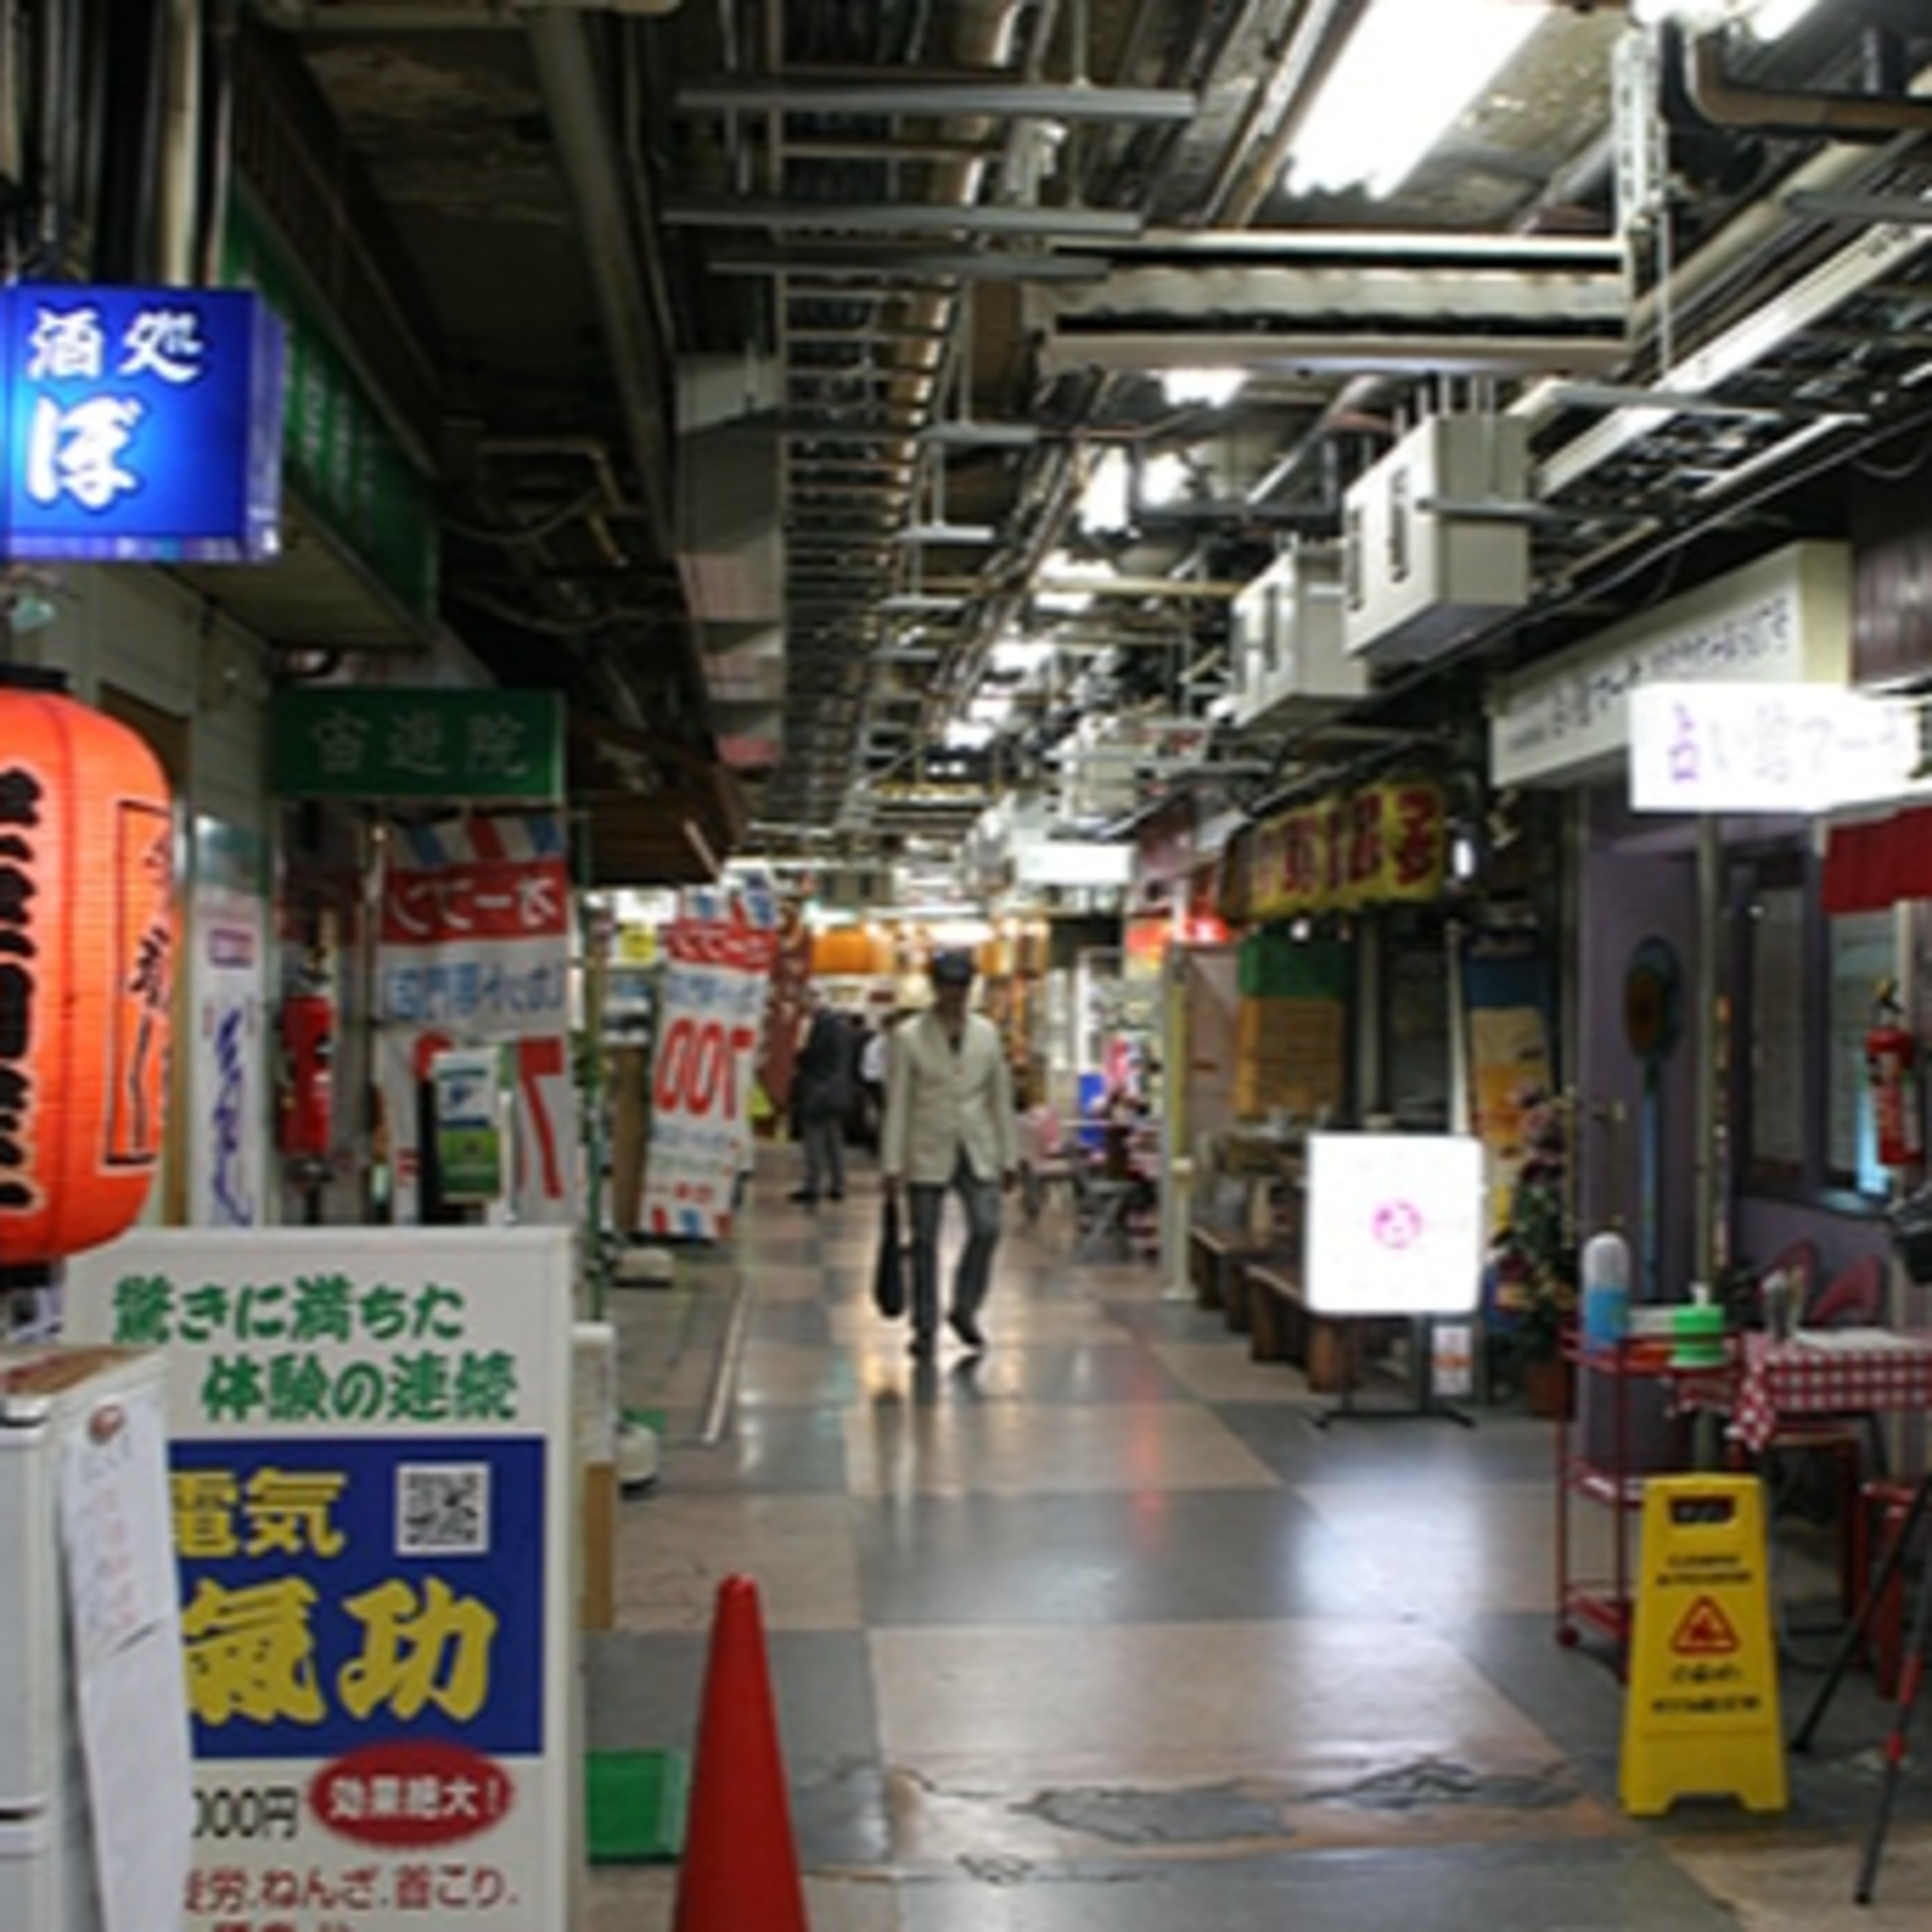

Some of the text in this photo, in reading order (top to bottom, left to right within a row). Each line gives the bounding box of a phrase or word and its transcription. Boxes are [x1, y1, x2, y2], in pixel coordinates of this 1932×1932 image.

[27, 309, 202, 382] 酒処
[112, 1274, 465, 1346] 驚きに満ちた
[201, 1352, 519, 1420] 体験の連続
[169, 1467, 346, 1557] 電気
[184, 1575, 498, 1726] 氣功
